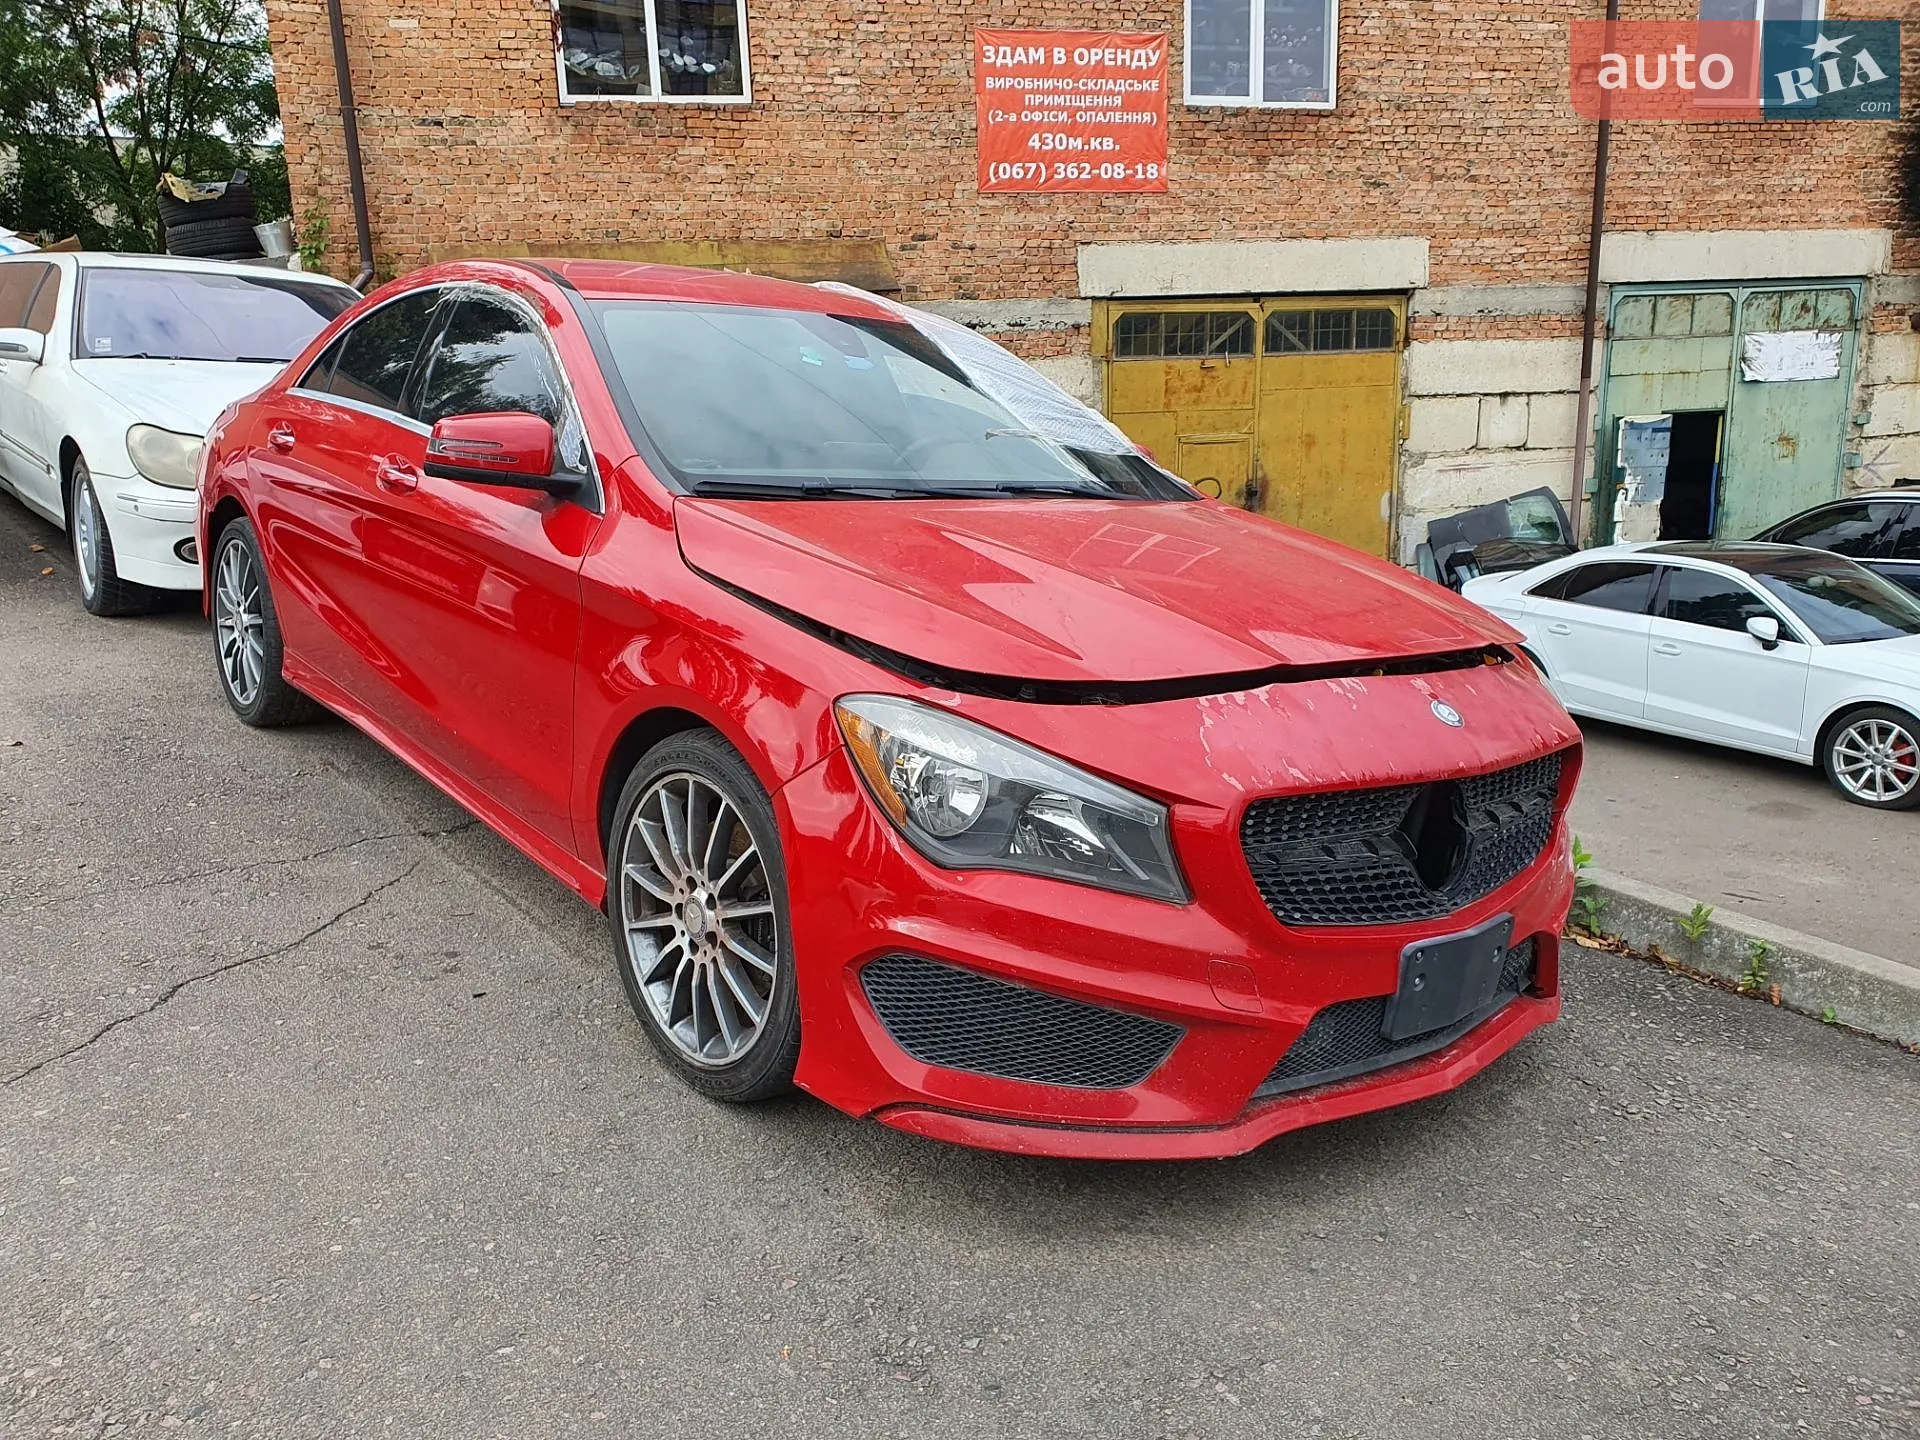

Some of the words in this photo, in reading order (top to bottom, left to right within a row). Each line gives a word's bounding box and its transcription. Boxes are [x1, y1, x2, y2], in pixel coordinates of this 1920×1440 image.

[982, 45, 1045, 67] ЗДАМ
[1052, 47, 1067, 65] В
[1073, 48, 1161, 69] ОРЕНДУ
[985, 77, 1160, 93] ВИРОБНИЧО-СКЛАДСЬКЕ
[1024, 94, 1122, 108] ПРИМІЩЕННЯ
[988, 109, 1017, 124] (2-а
[1021, 110, 1072, 125] ОФІСИ,
[1076, 111, 1158, 126] ОПАЛЕННЯ)
[1028, 133, 1121, 151] 430м.кв.
[988, 162, 1047, 184] (067)
[1053, 163, 1159, 180] 362-08-18
